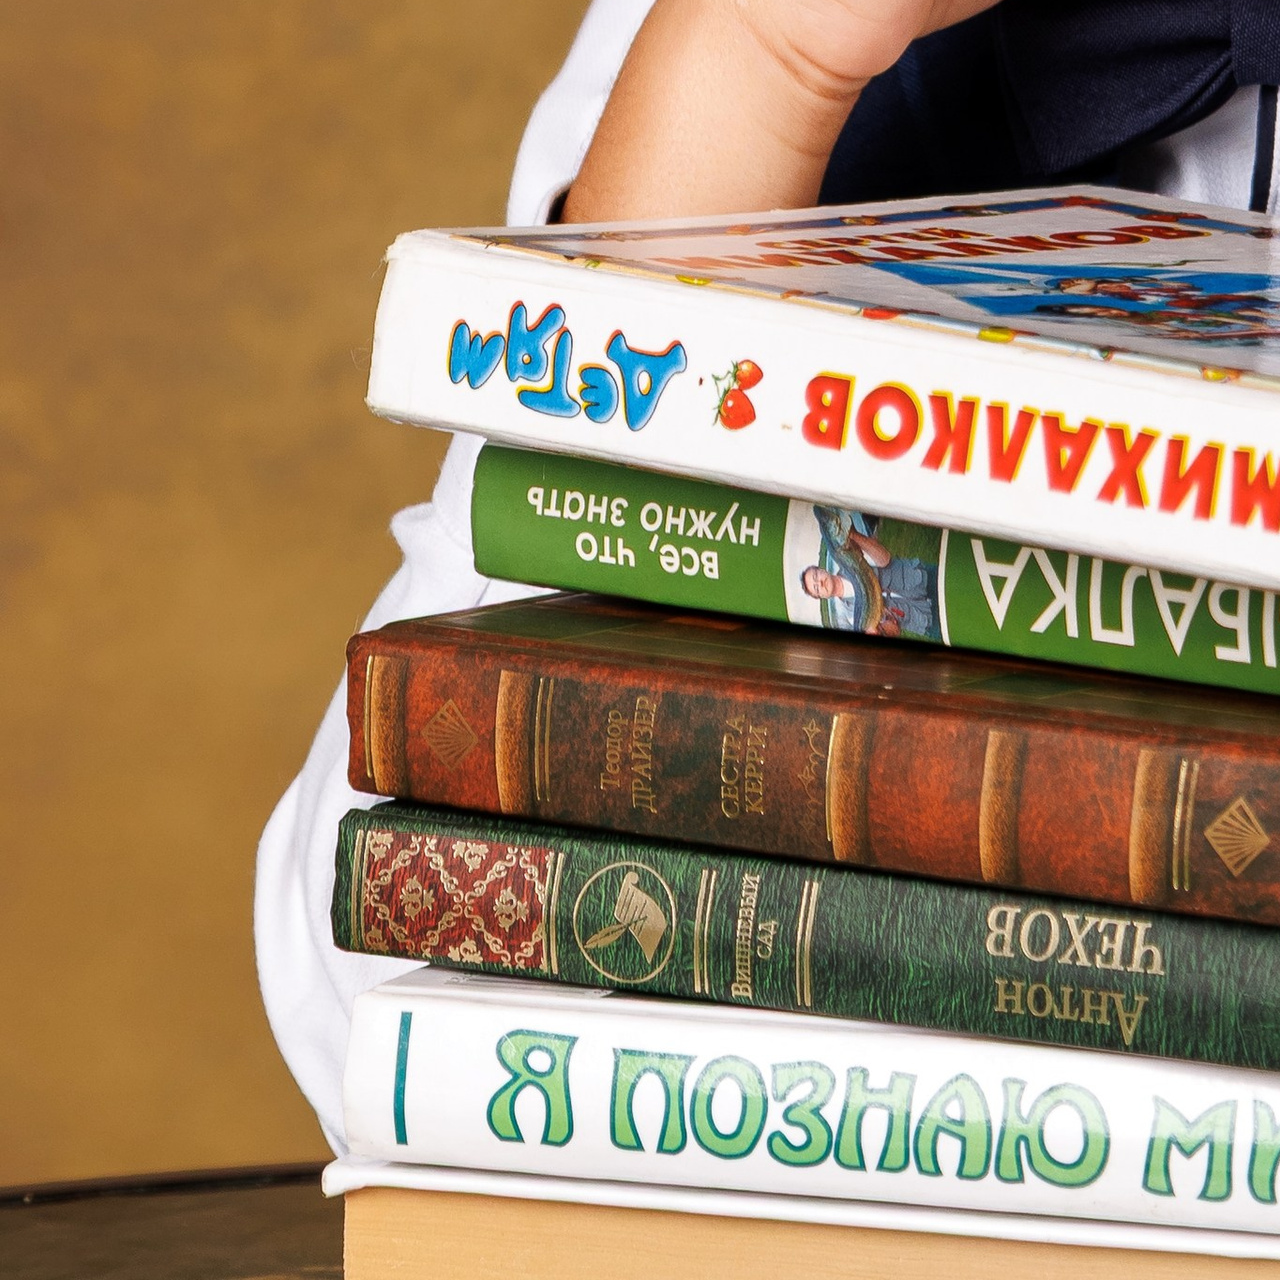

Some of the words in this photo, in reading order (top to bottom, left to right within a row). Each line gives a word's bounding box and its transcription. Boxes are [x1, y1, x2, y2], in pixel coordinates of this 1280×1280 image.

[575, 531, 636, 568] что
[600, 709, 628, 790] Теодор
[631, 695, 657, 814] ДРАЙЗЕР
[720, 714, 746, 819] СЕСТРА
[744, 725, 768, 815] КЕРРИ
[986, 904, 1166, 975] ЧЕХОВ
[486, 1029, 580, 1148] Я
[610, 1047, 1110, 1189] ПОЗНАЮ
